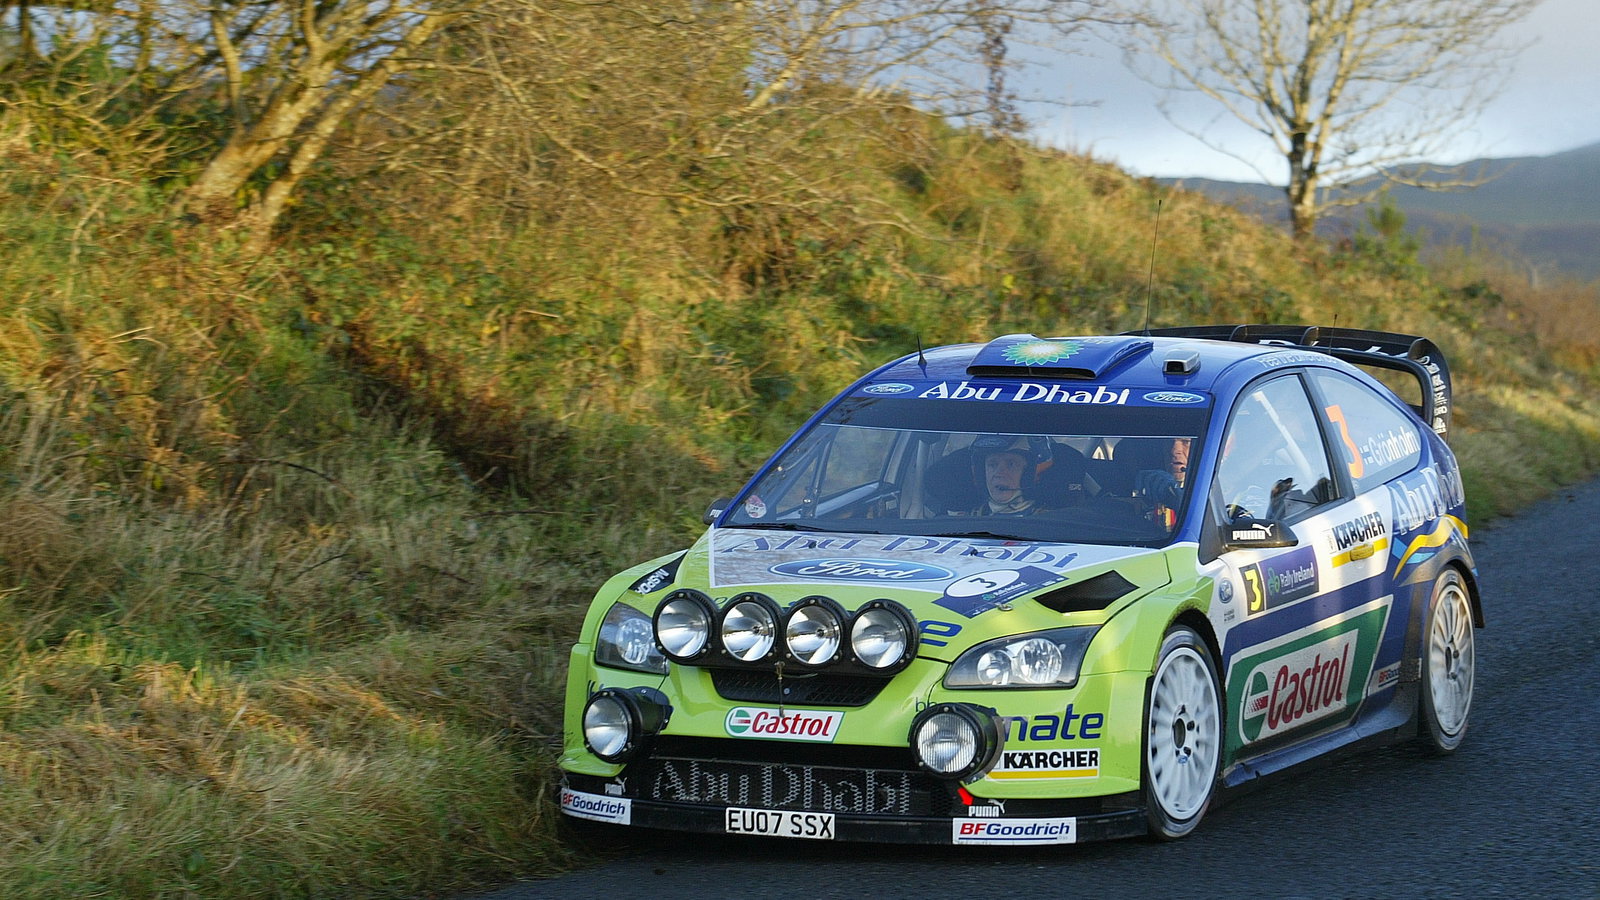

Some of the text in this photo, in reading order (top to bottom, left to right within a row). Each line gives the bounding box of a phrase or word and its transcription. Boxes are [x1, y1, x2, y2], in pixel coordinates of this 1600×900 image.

[918, 381, 1131, 405] Abu Dhabi
[1153, 392, 1193, 402] Ford
[1325, 404, 1365, 479] 3
[1367, 426, 1420, 467] Grönholm
[1389, 480, 1437, 536] Abu
[1232, 529, 1266, 541] PUMA
[721, 535, 1080, 568] Abu Dhabi
[634, 568, 670, 595] M-SPOR
[797, 558, 924, 580] Ford
[967, 577, 998, 589] 3
[1244, 569, 1262, 612] 3
[1267, 642, 1350, 730] Castrol
[751, 711, 833, 737] Castrol
[1003, 750, 1099, 769] KÄRCHER
[651, 760, 910, 816] Abu Dhabi
[562, 792, 626, 815] BFGoodrich
[968, 805, 1000, 818] PUMA
[728, 810, 834, 838] EU07 SSX
[959, 822, 1071, 836] BFGoodrich
